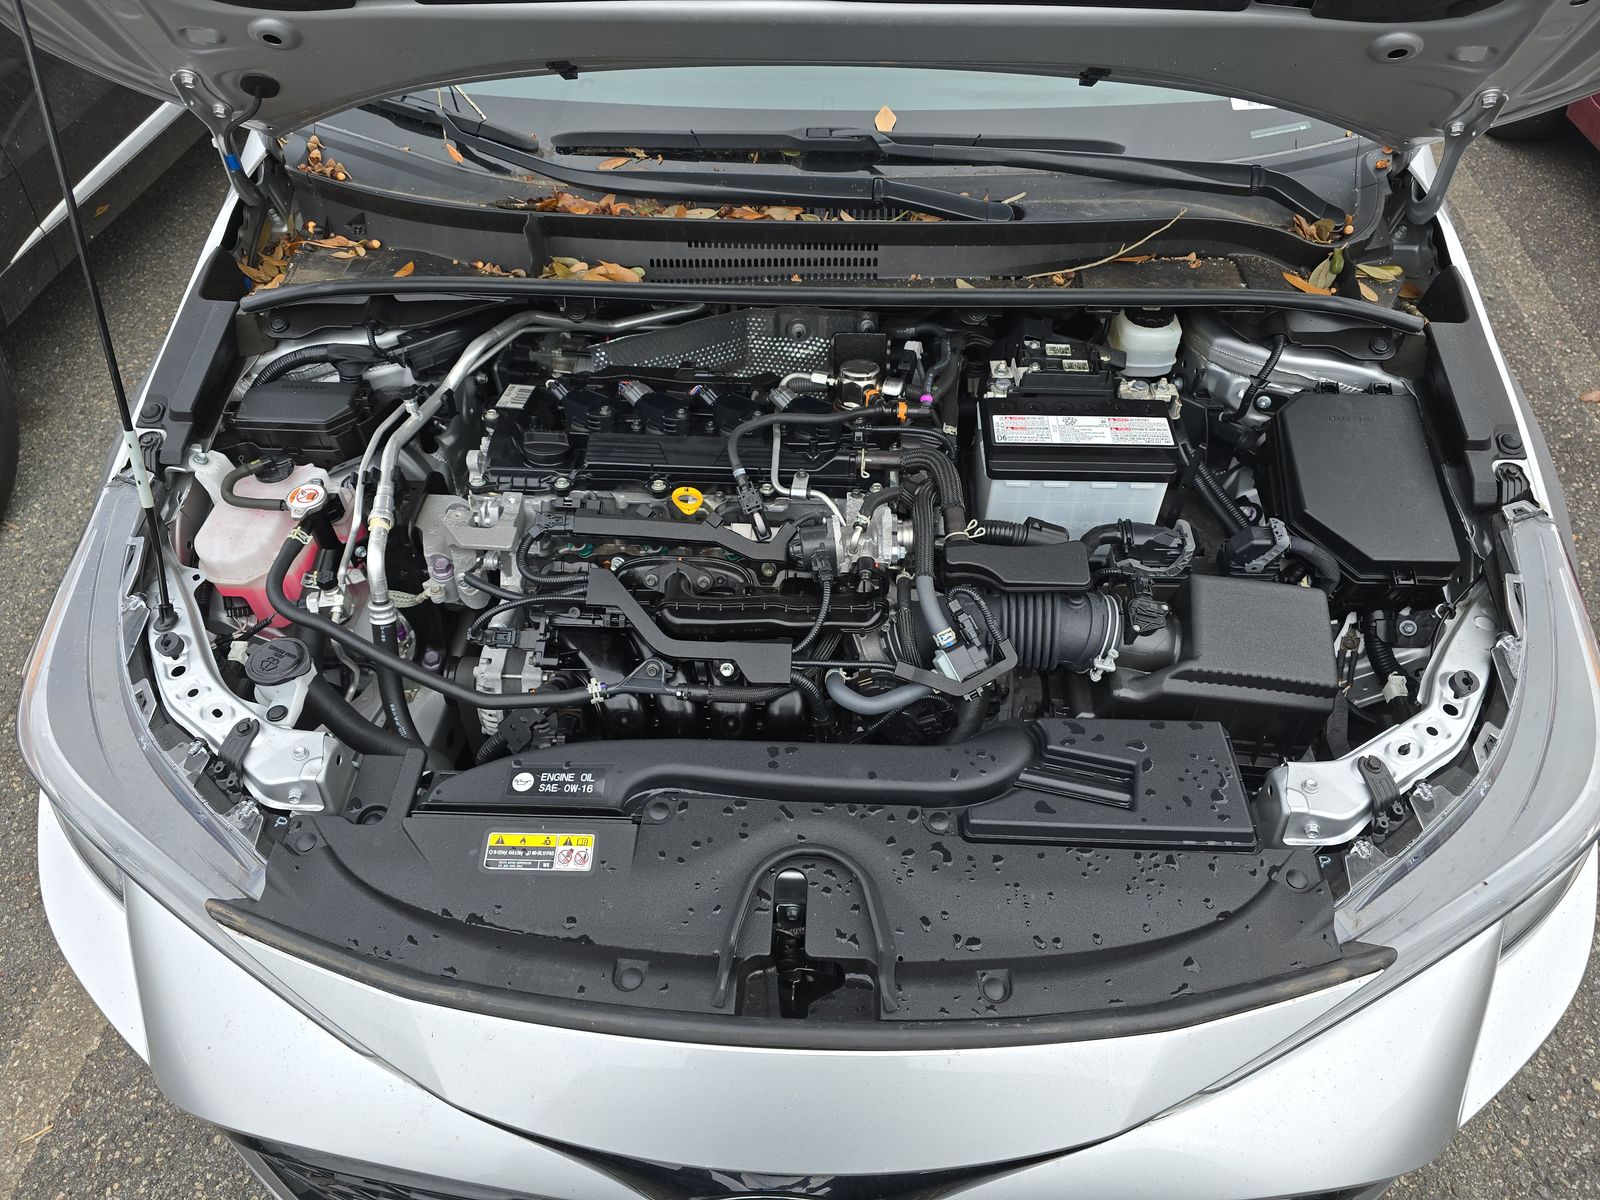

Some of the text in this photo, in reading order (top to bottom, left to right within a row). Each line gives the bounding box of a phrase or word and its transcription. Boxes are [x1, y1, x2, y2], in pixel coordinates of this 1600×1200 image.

[540, 773, 595, 782] ENGINE OIL
[538, 783, 594, 793] SAE 0W-16
